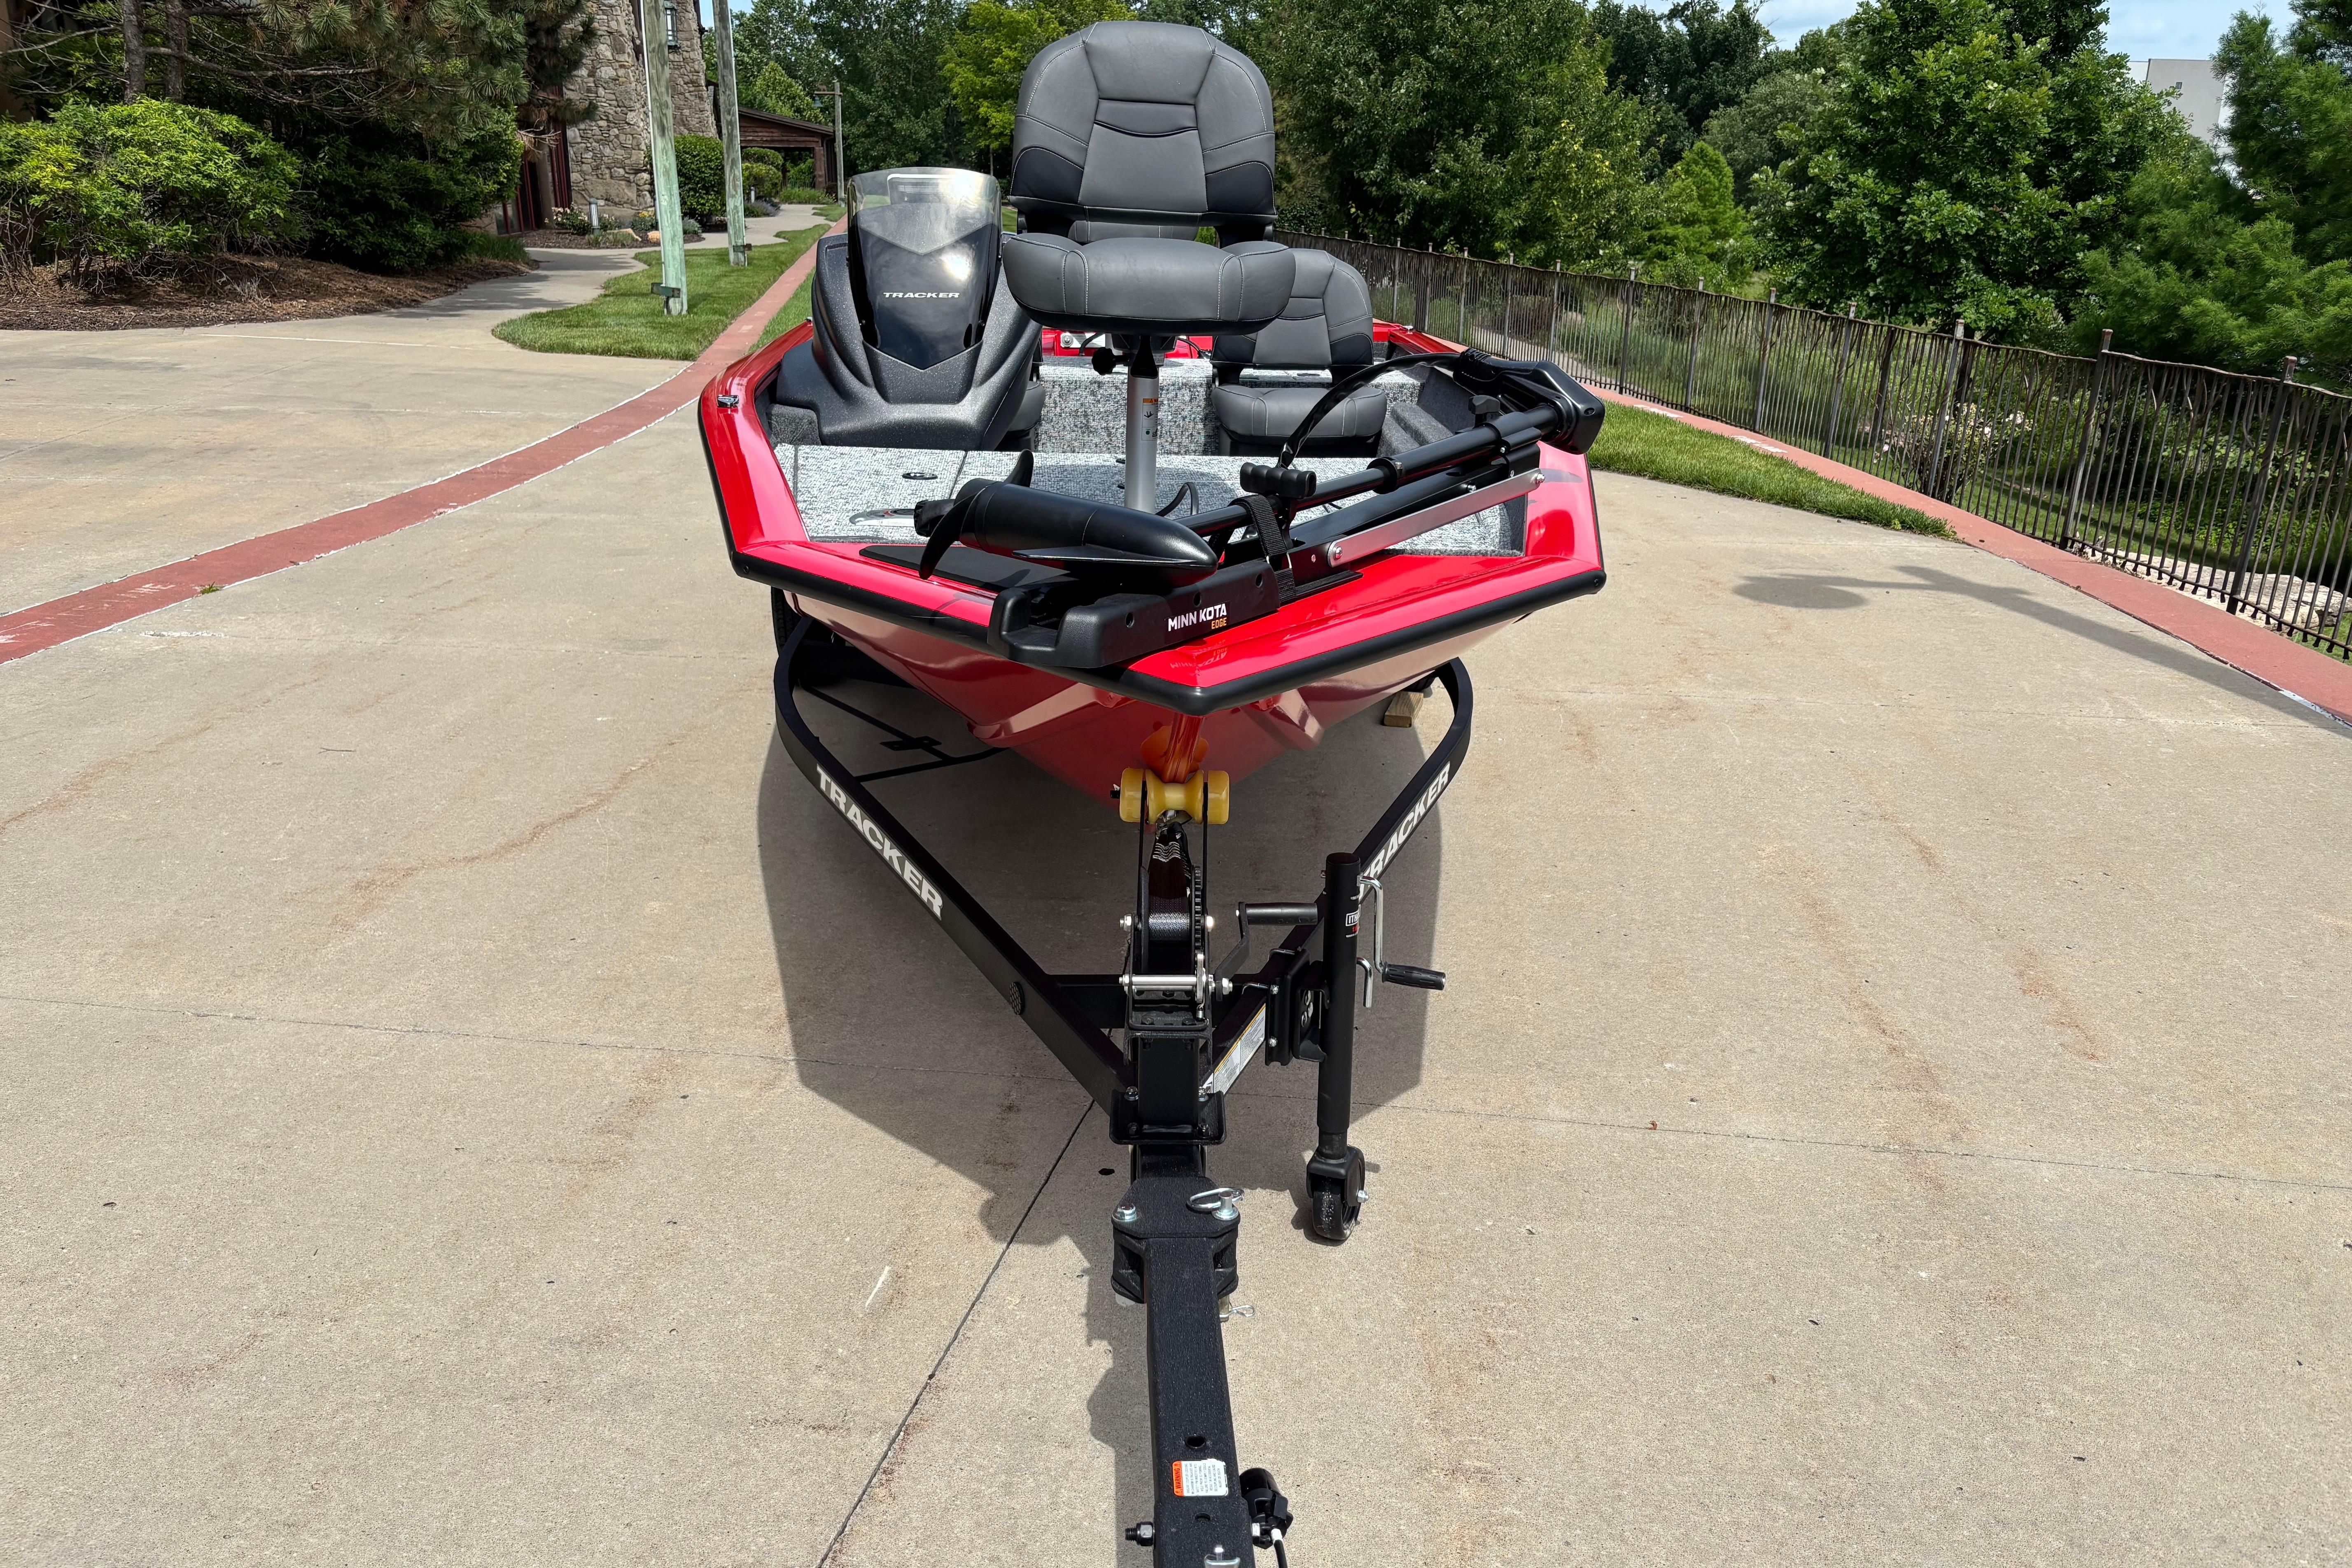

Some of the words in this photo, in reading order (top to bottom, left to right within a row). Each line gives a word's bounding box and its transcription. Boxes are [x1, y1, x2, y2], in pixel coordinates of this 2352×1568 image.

[1168, 611, 1197, 632] MINN
[1199, 603, 1227, 623] KOTA
[1211, 617, 1227, 630] EDGE
[817, 763, 943, 921] TRACKER
